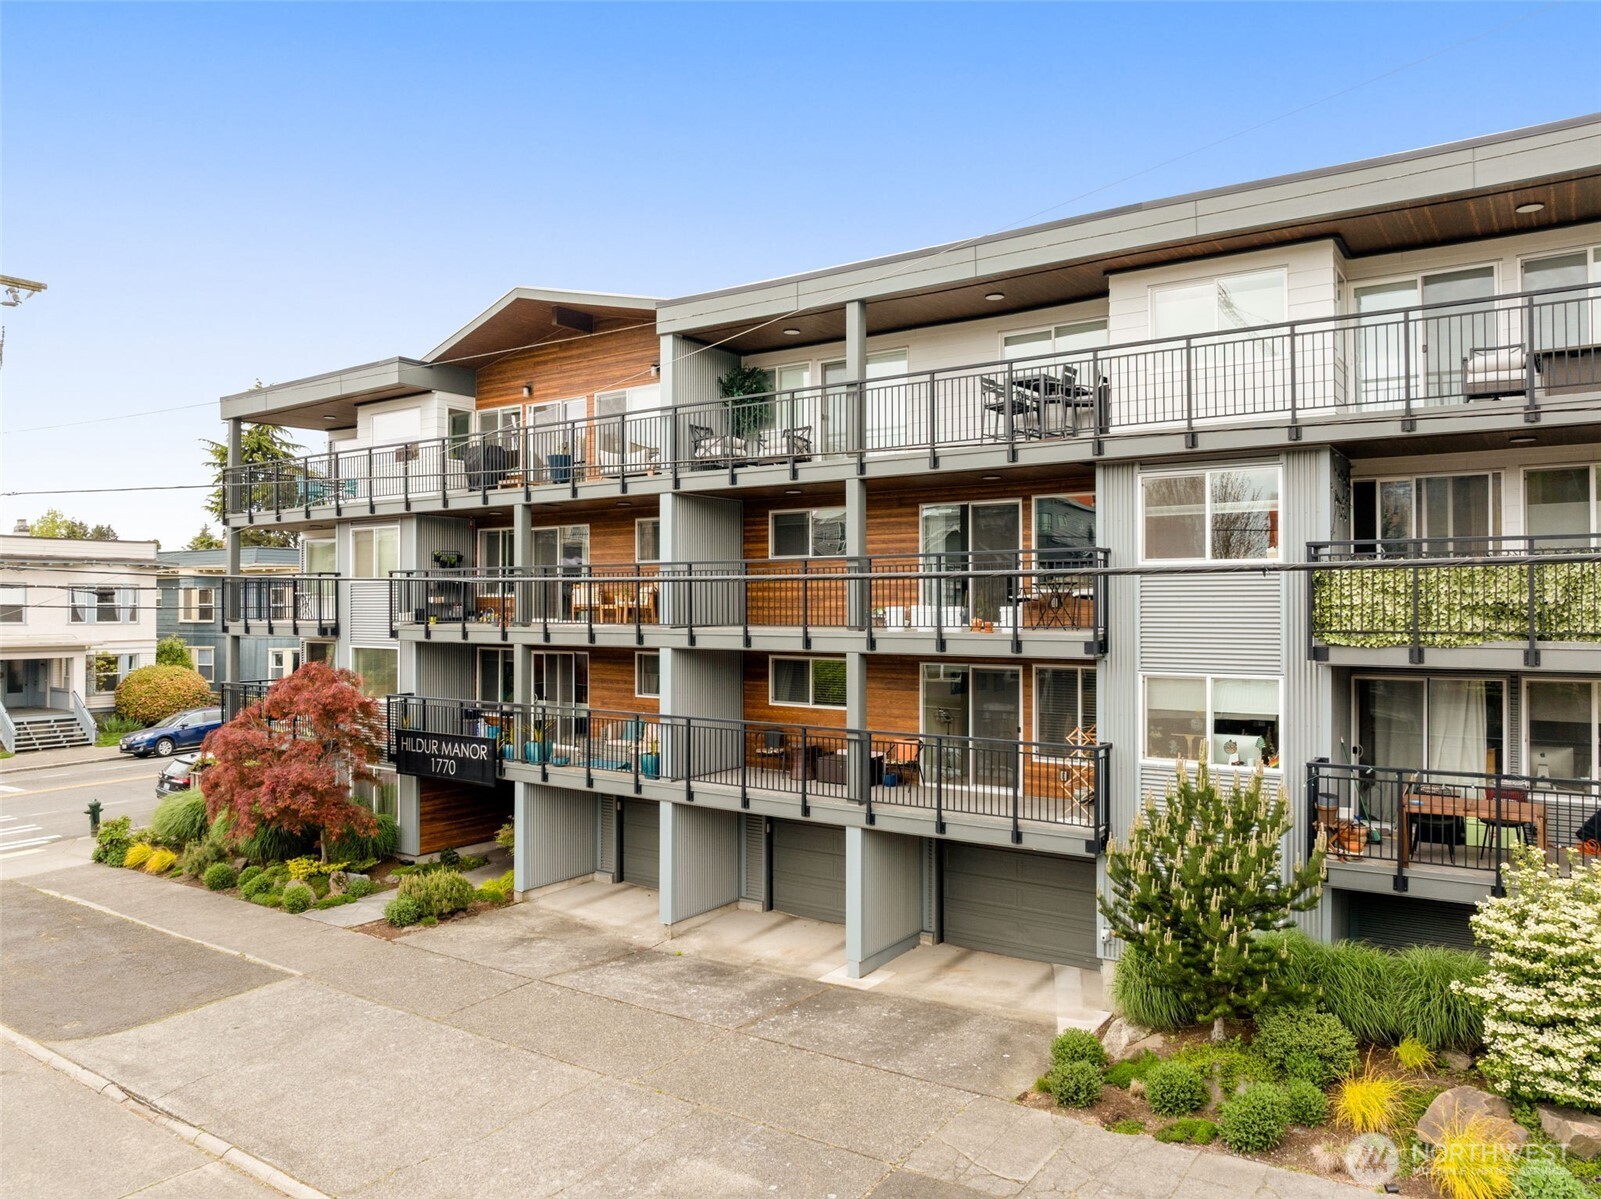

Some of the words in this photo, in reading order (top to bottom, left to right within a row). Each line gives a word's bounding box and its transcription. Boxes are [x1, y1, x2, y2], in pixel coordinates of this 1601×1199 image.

[401, 737, 438, 755] HILDUR
[441, 741, 487, 760] MANOR
[431, 758, 456, 775] 1770
